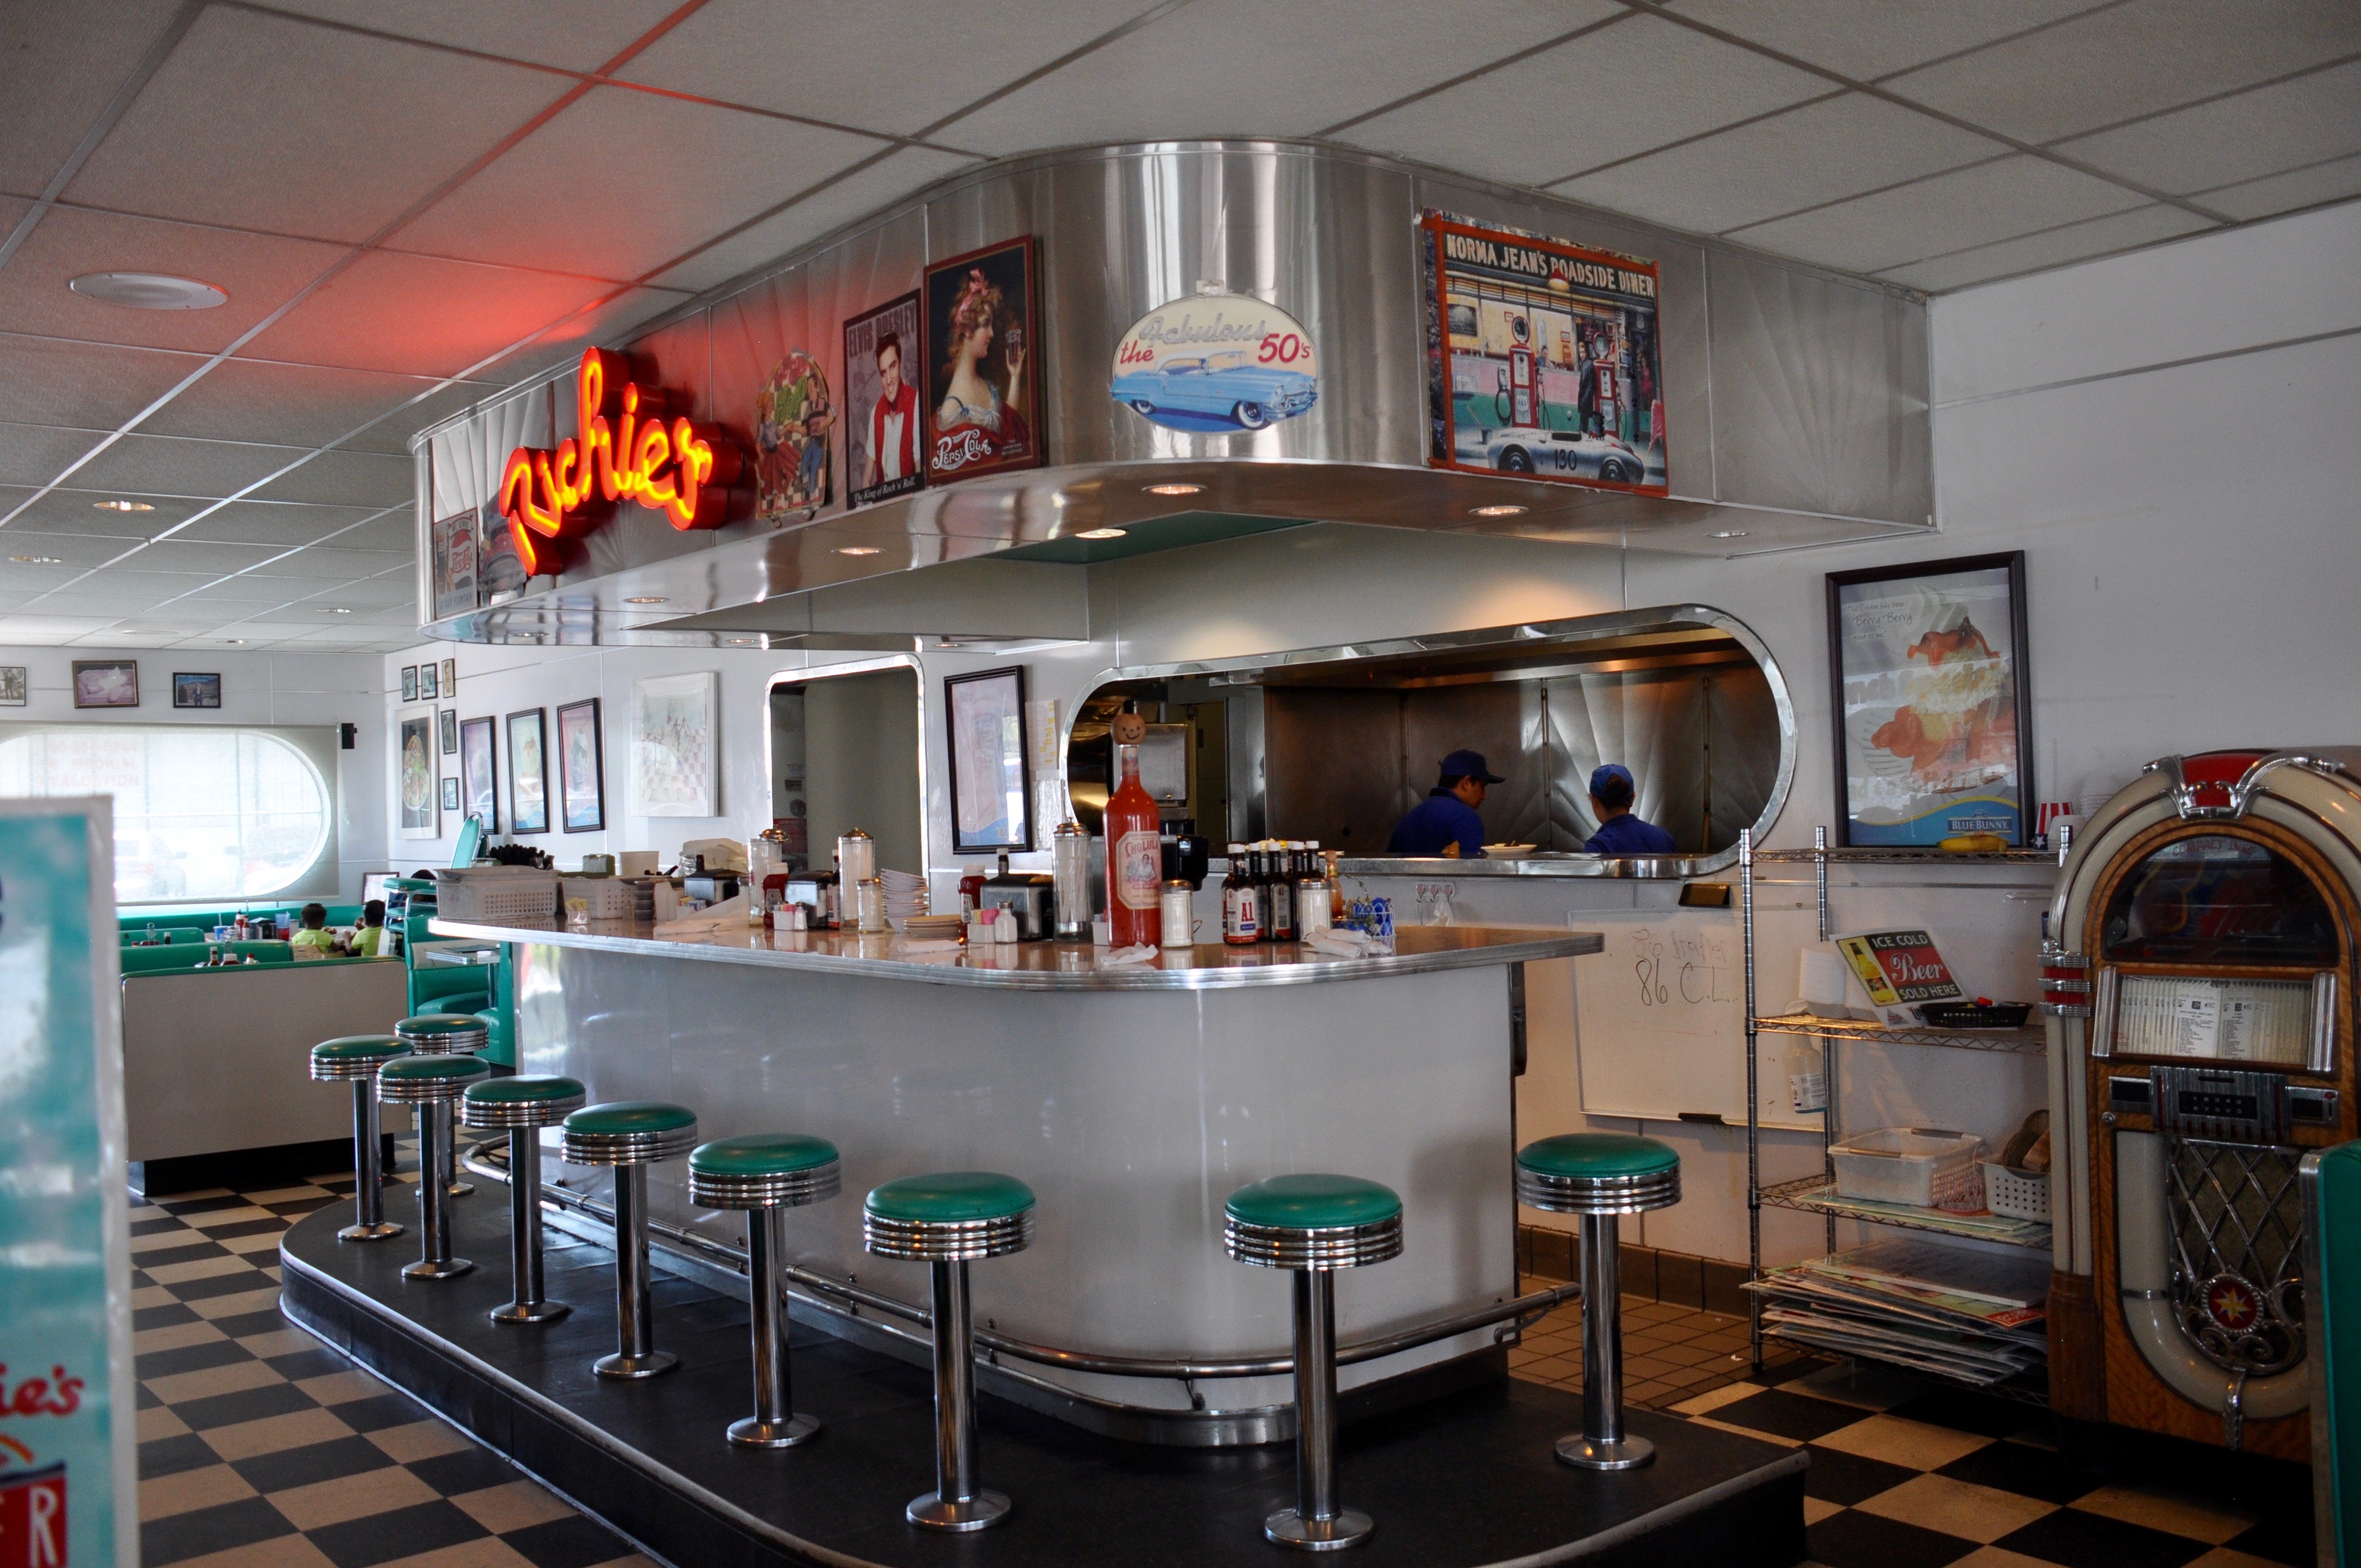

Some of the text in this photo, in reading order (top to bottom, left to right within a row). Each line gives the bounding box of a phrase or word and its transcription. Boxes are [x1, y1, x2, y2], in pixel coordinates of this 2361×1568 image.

[1446, 233, 1498, 266] NORMA
[1501, 247, 1547, 276] JEAN'S
[1618, 270, 1655, 297] DINER
[1119, 312, 1310, 364] the Fabulous 50's
[1554, 449, 1577, 471] 130
[1852, 612, 1912, 628] Berry Berry
[1952, 820, 2008, 830] BLUE BUNNY
[1872, 934, 1928, 948] ICE COLD
[1890, 952, 1944, 982] Beer
[1636, 957, 1668, 1006] 86
[1900, 984, 1960, 1000] SOLD HERE
